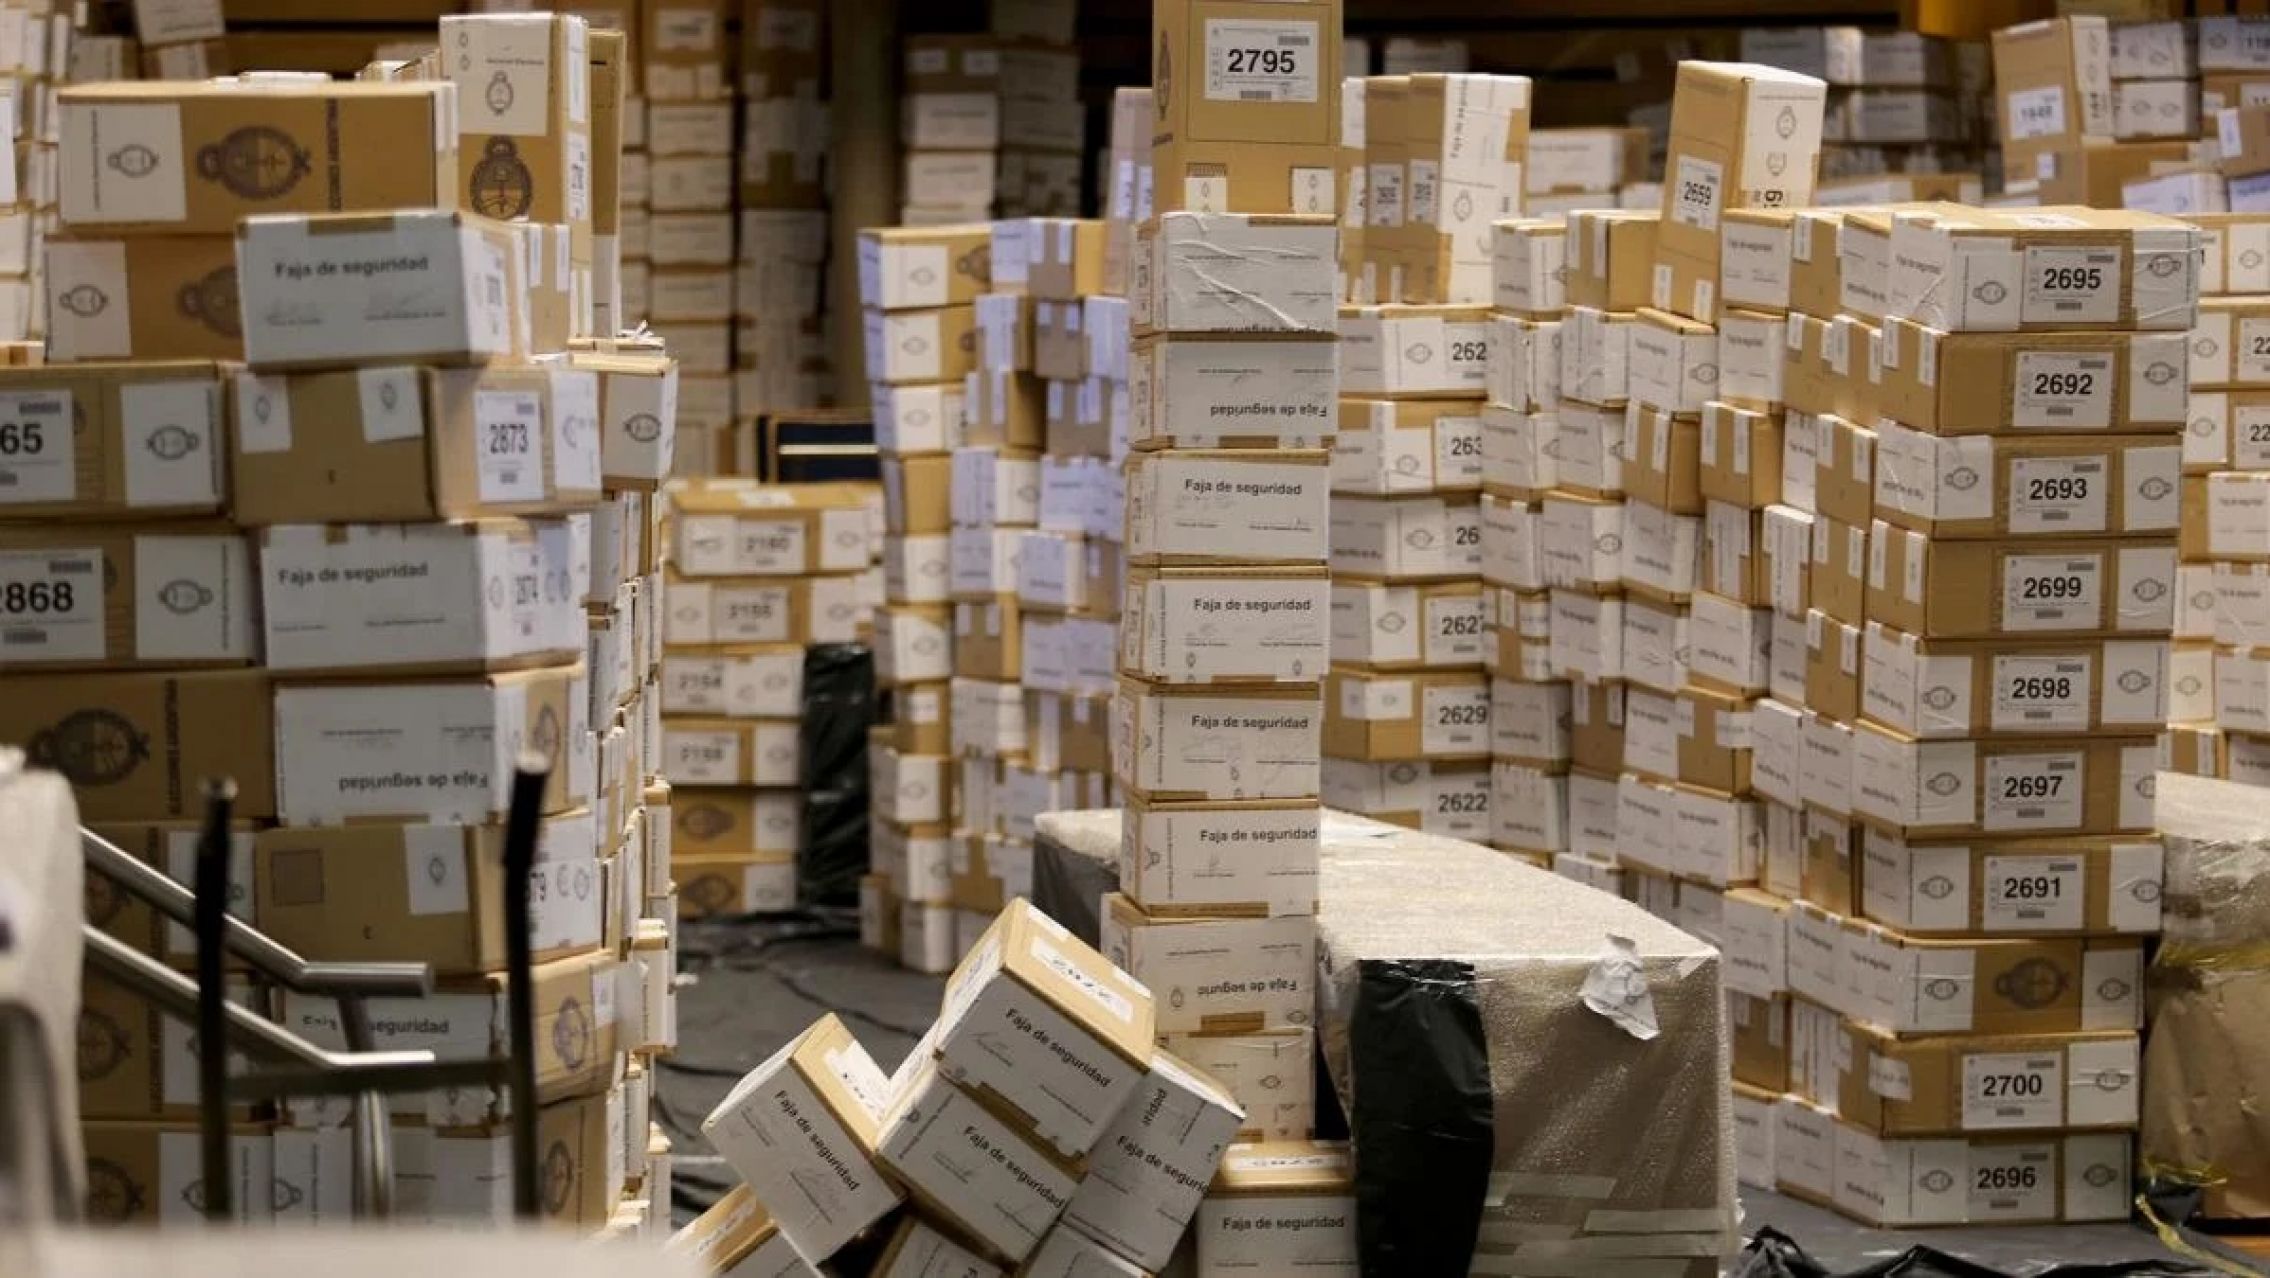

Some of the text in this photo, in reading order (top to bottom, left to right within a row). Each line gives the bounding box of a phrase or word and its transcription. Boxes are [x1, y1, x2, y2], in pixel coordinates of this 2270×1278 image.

[1227, 48, 1295, 74] 2795
[274, 256, 430, 281] Faja de seguridad
[2043, 268, 2103, 290] 2695
[2034, 374, 2094, 395] 2692
[1210, 402, 1327, 418] Faja de seguridad
[1185, 478, 1303, 497] Faja de seguridad
[2029, 478, 2088, 500] 2693
[278, 562, 429, 588] Faja de seguridad
[2023, 577, 2082, 599] 2699
[1194, 598, 1312, 614] Faja de seguridad
[2012, 677, 2071, 700] 2698
[1191, 714, 1309, 731] Faja de seguridad
[1438, 705, 1488, 726] 2629
[338, 769, 489, 793] Faja de seguridad
[2004, 776, 2064, 799] 2697
[1437, 793, 1488, 813] 2622
[1200, 827, 1318, 844] Faja de seguridad
[2004, 878, 2062, 900] 2691
[1249, 981, 1266, 993] de
[1268, 977, 1297, 992] Faja
[1004, 1008, 1113, 1088] Faja de seguridad
[1982, 1074, 2043, 1097] 2700
[774, 1089, 862, 1192] Faja de seguridad
[1116, 1135, 1145, 1159] Faja
[1144, 1152, 1163, 1169] de
[963, 1125, 1067, 1209] Faja de seguridad
[1976, 1167, 2036, 1190] 2696
[1223, 1215, 1346, 1232] Faja de seguridad
